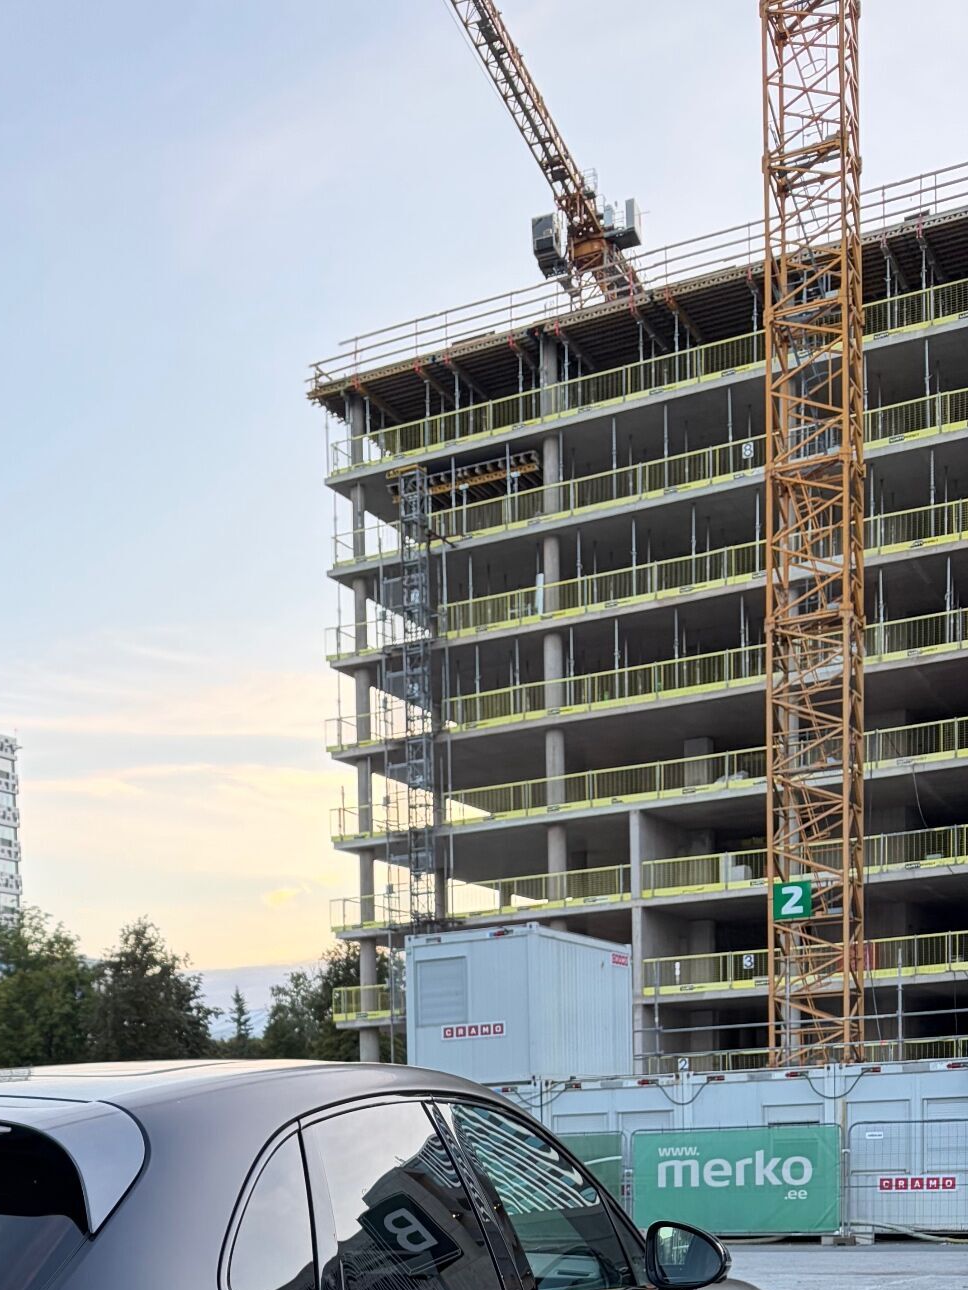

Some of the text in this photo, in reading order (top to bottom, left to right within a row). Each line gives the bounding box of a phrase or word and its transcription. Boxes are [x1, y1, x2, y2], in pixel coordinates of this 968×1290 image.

[744, 444, 752, 457] 8
[781, 886, 803, 915] 2
[744, 956, 753, 968] 3
[445, 1025, 502, 1037] CRAMO
[679, 1059, 688, 1071] 2
[658, 1146, 700, 1157] www.
[657, 1149, 813, 1188] merko
[881, 1178, 954, 1190] CRAMO
[784, 1189, 808, 1200] .ee
